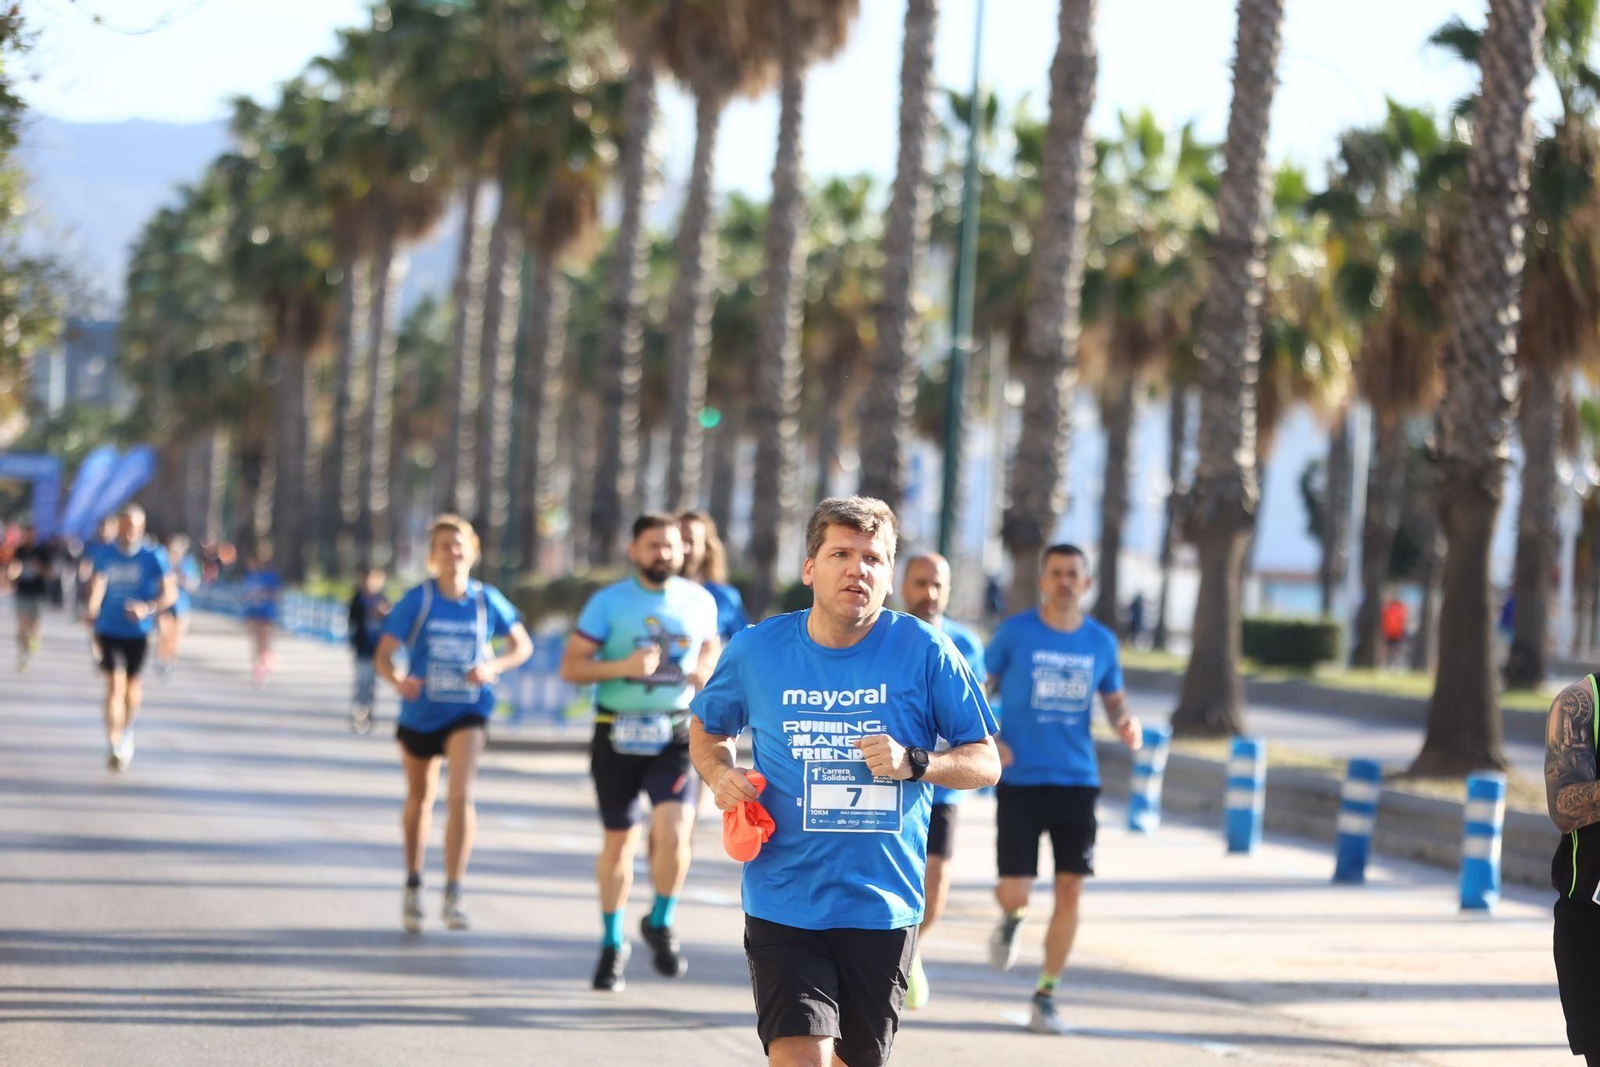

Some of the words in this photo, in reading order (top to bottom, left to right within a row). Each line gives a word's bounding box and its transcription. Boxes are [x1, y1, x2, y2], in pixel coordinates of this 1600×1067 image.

[782, 683, 887, 711] mayoral
[782, 720, 881, 734] RUNNING
[792, 733, 864, 748] MAKE
[791, 747, 864, 760] FRIEND
[822, 767, 851, 775] Carrera
[846, 787, 863, 807] 7
